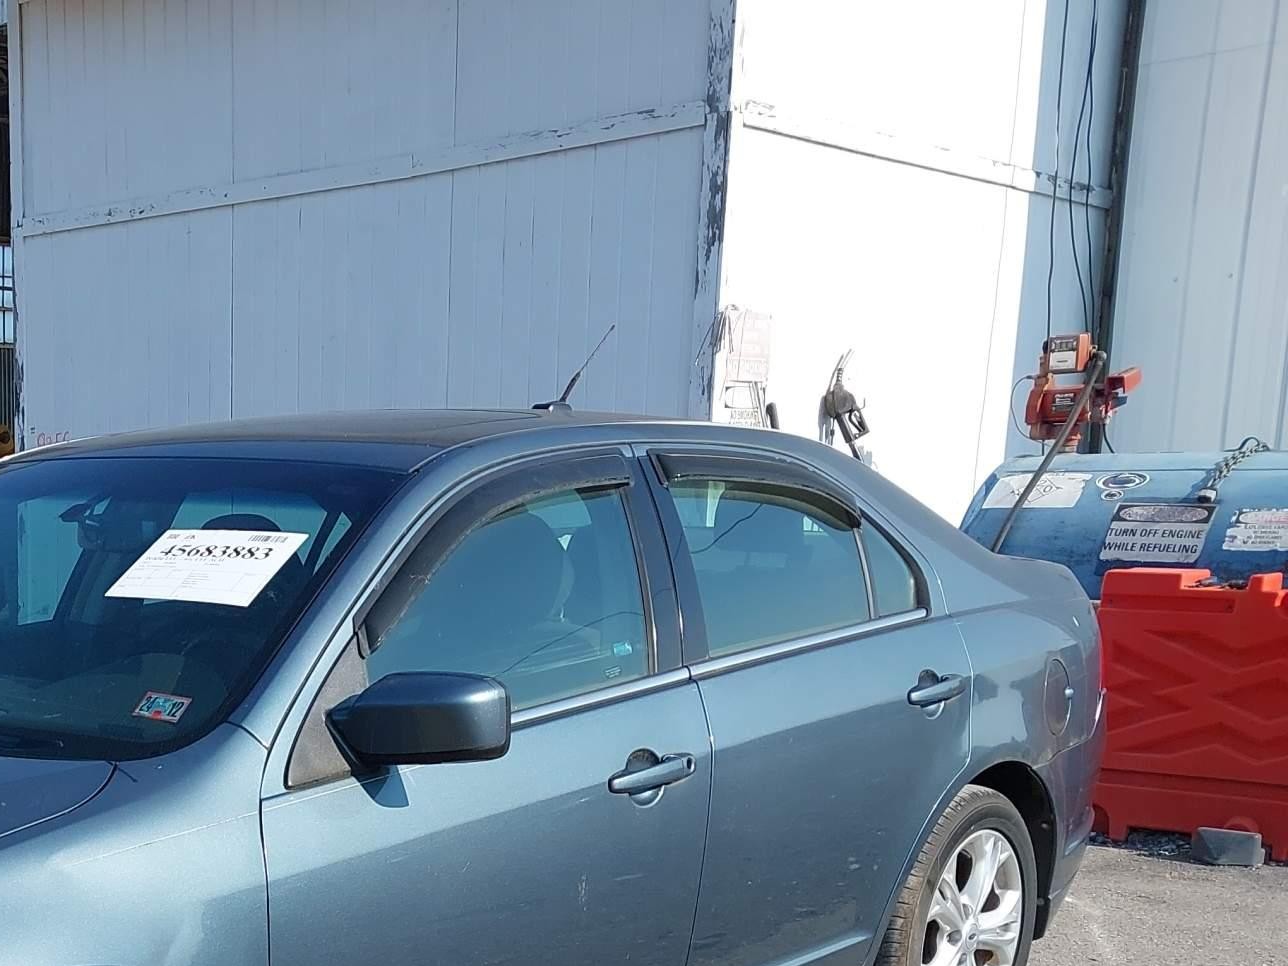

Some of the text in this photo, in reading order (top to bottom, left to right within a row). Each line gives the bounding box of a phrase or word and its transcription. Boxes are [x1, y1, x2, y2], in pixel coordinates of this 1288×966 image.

[1108, 527, 1204, 539] TURN OFF ENGINE
[160, 544, 273, 560] 45683883
[1103, 541, 1199, 554] WHILE REFUELING
[139, 696, 185, 717] 24 12
